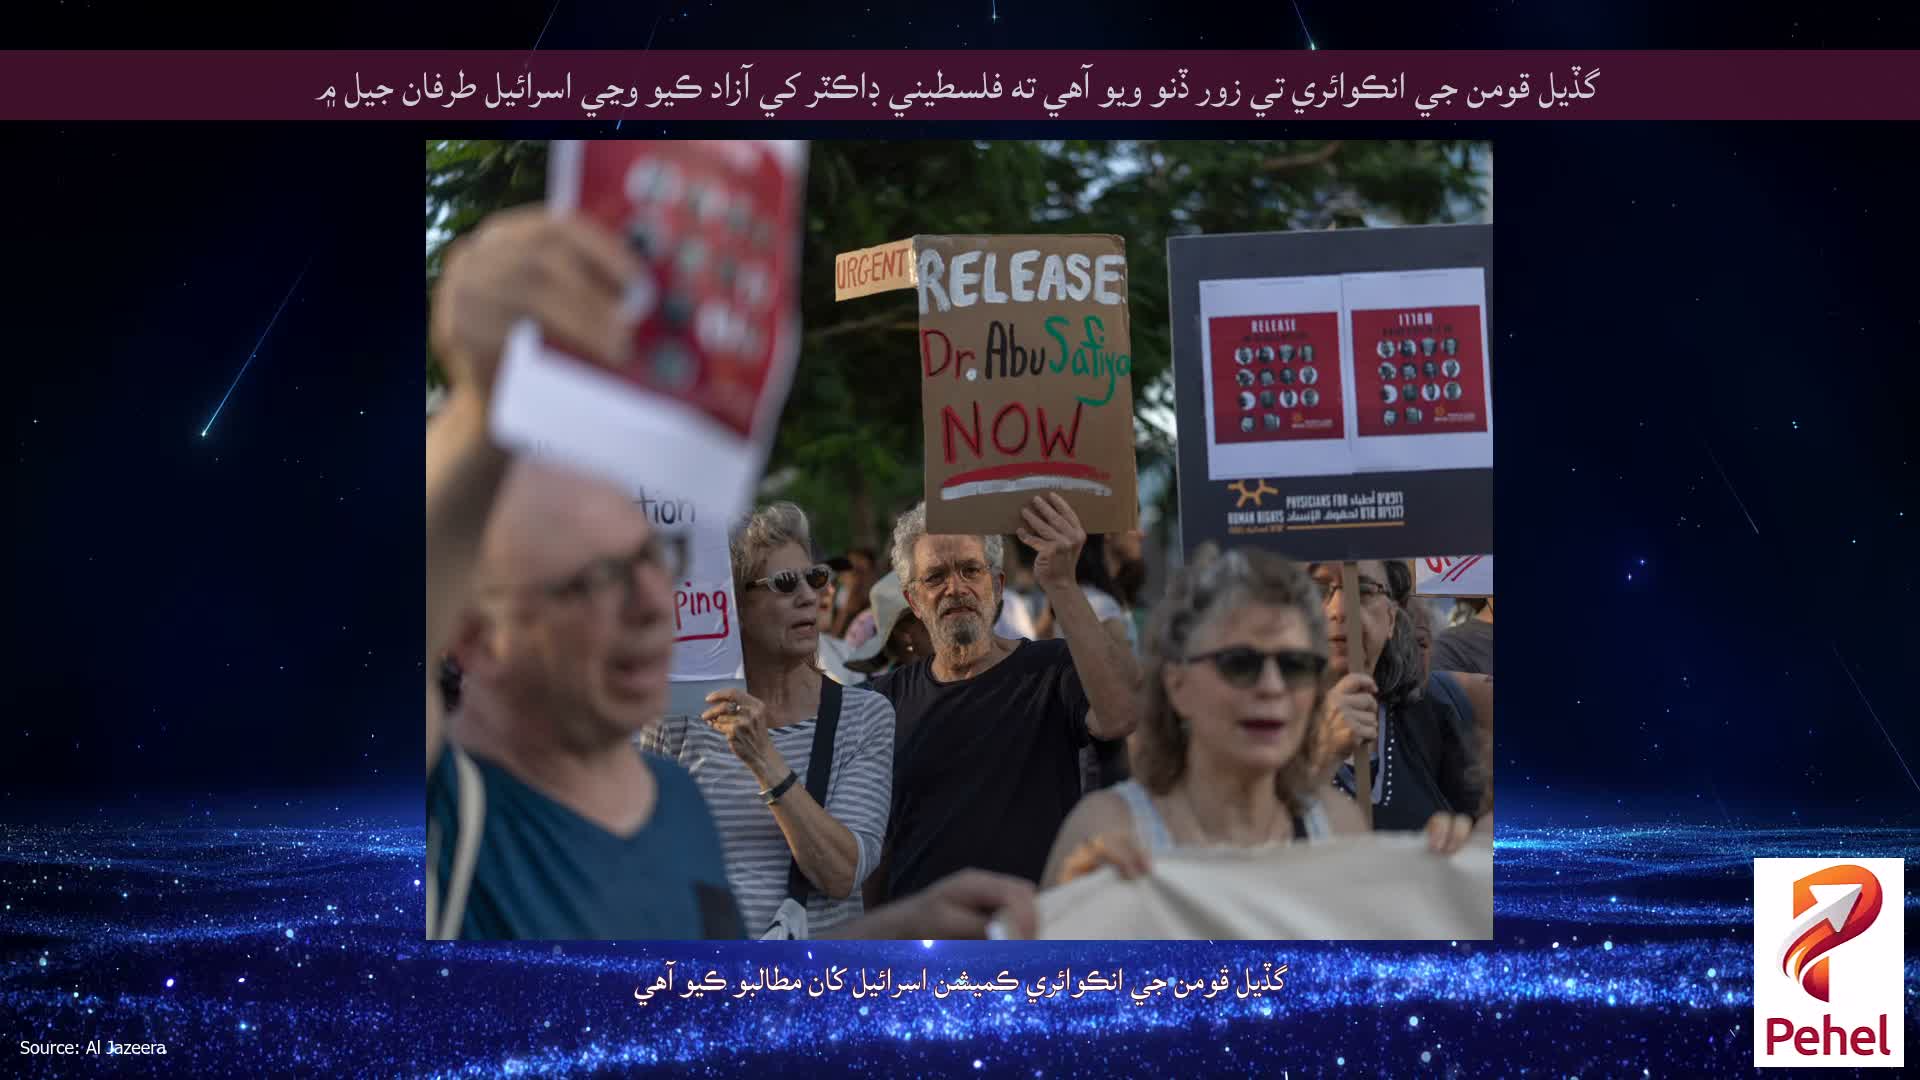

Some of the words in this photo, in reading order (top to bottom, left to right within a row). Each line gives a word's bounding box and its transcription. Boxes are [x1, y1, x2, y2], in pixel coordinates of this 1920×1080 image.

[836, 248, 908, 289] URGENT
[918, 249, 1126, 315] RELEASE
[1251, 319, 1296, 333] RELEASE
[921, 329, 977, 380] Dr.
[985, 320, 1045, 380] Abu
[941, 400, 1083, 464] NOW
[1228, 511, 1255, 524] HUMAN
[1257, 510, 1284, 523] RIGHTS
[1286, 496, 1331, 509] PHYSICIANS
[1333, 494, 1348, 507] FOR
